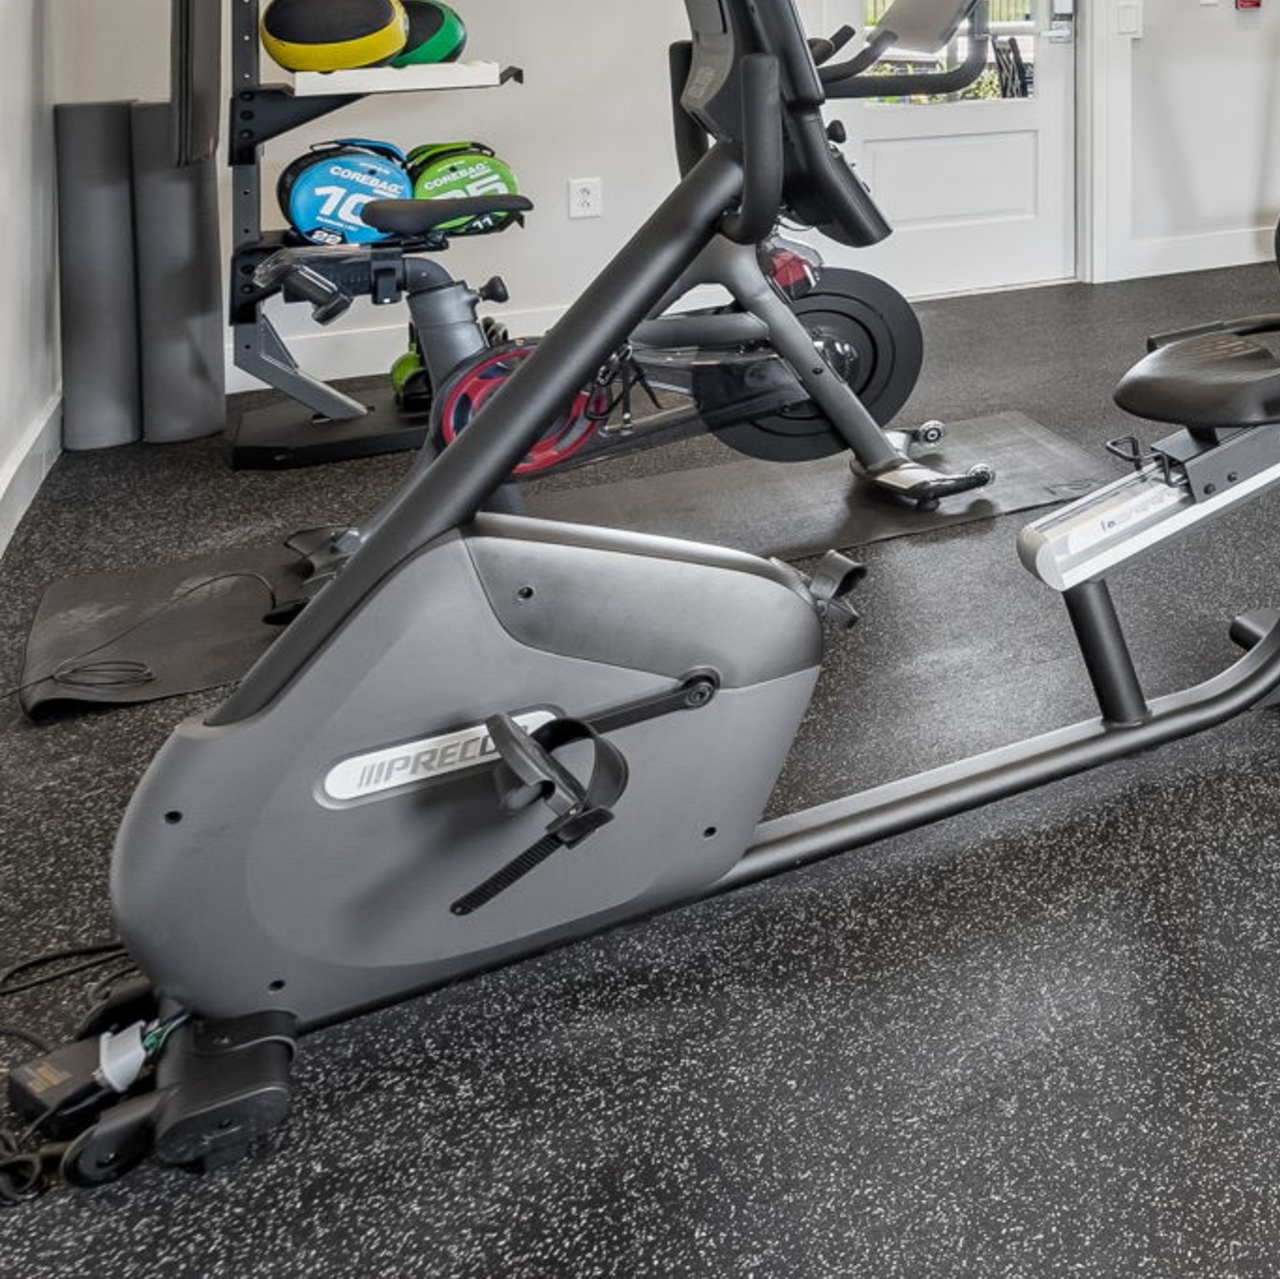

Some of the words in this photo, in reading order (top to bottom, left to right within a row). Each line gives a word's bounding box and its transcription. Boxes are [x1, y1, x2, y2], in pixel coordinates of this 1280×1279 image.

[329, 165, 400, 195] COREBAG
[423, 162, 486, 190] COREBAG
[471, 216, 494, 230] 11
[384, 724, 528, 781] PRECO
